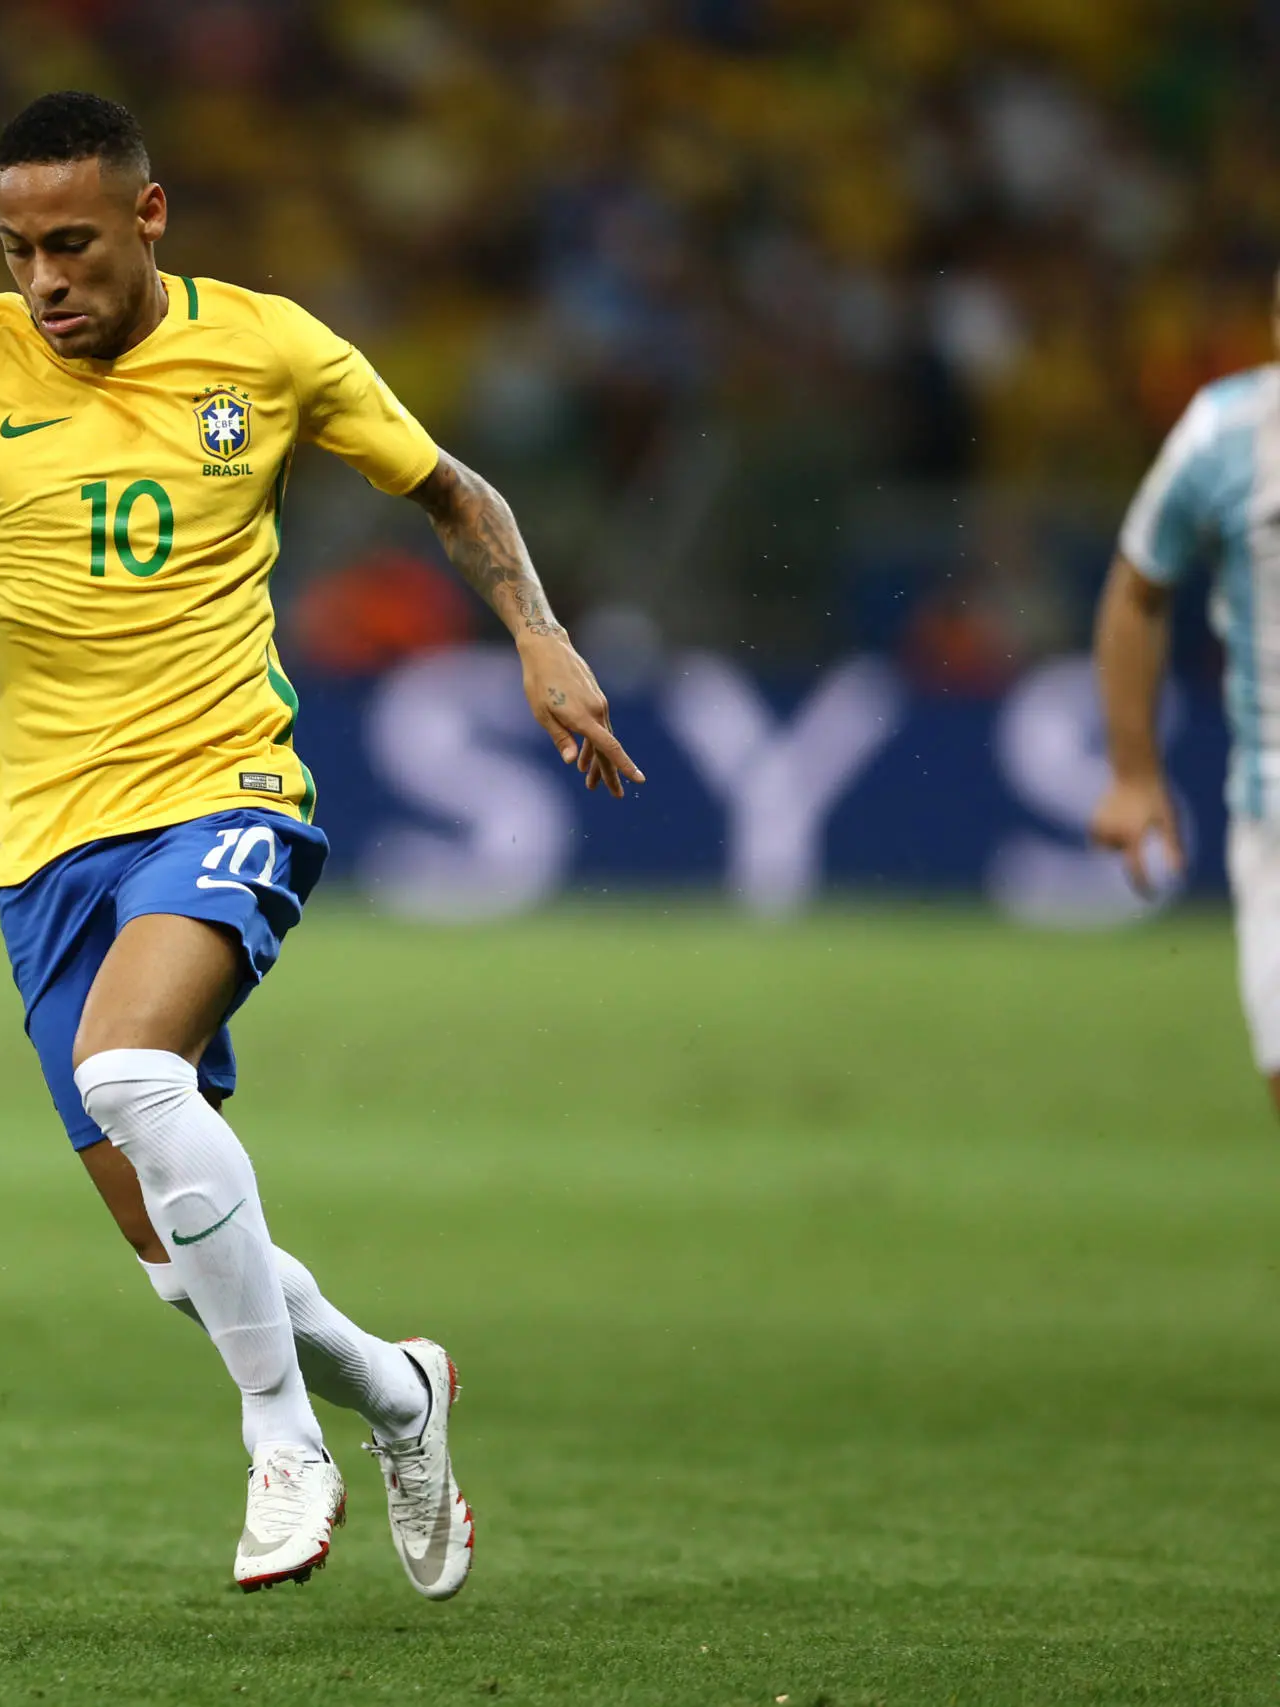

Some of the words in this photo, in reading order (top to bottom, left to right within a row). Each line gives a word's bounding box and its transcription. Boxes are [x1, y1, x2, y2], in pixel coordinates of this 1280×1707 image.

[214, 420, 234, 429] CBF
[202, 464, 253, 476] BRASIL
[81, 479, 174, 577] 10
[201, 826, 275, 887] 10
